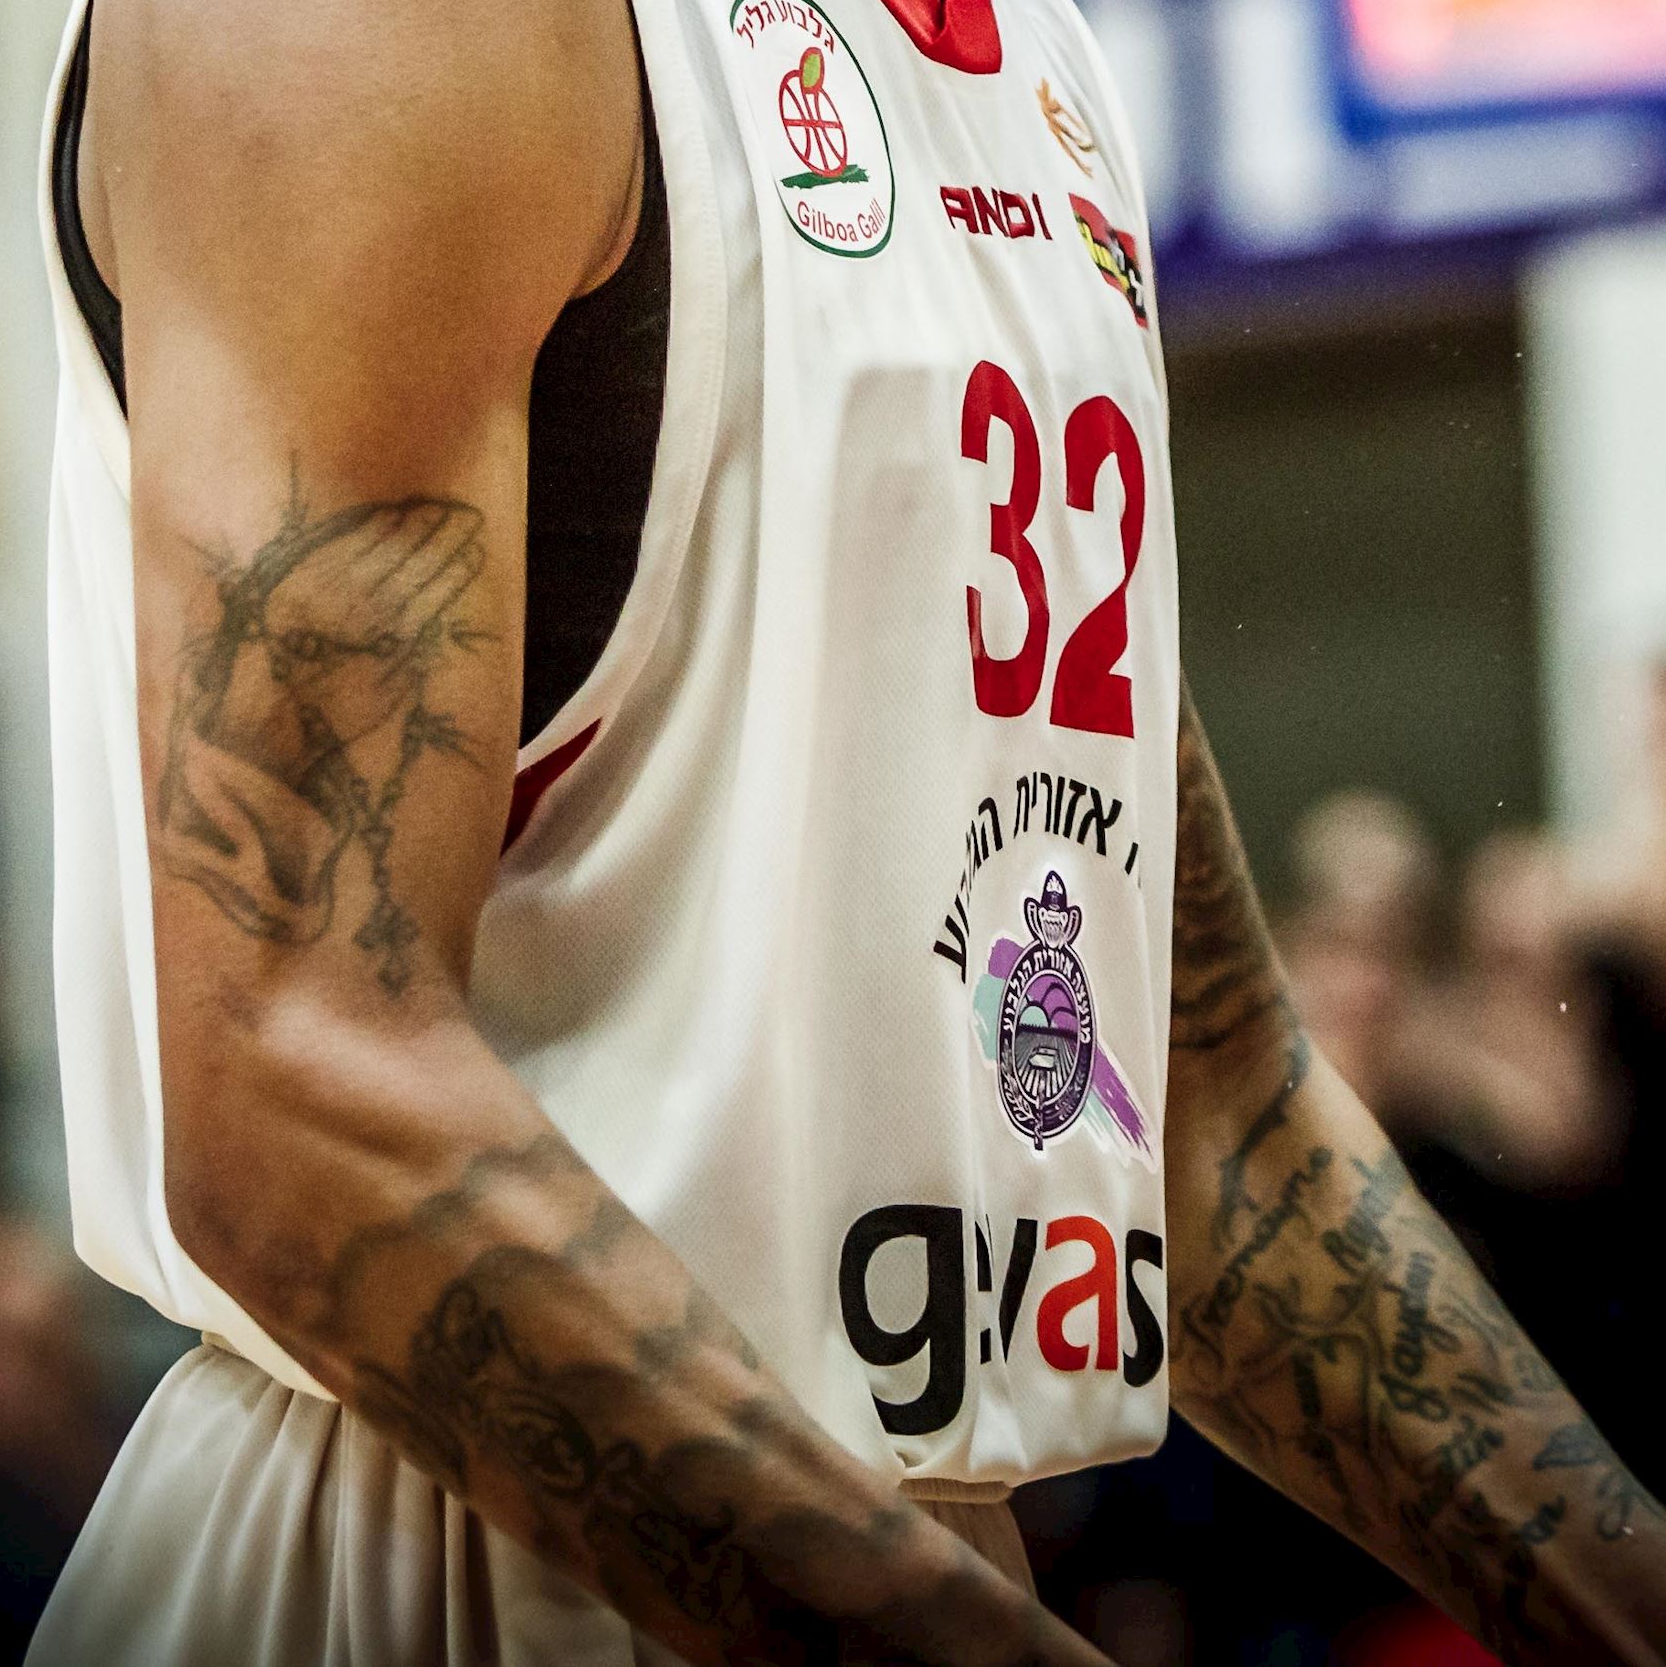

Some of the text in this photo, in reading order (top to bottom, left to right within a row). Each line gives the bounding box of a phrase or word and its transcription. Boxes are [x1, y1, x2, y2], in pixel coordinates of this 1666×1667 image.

[797, 197, 886, 242] Gilboa Galil
[961, 360, 1145, 738] 32
[1014, 772, 1122, 856] אזורית
